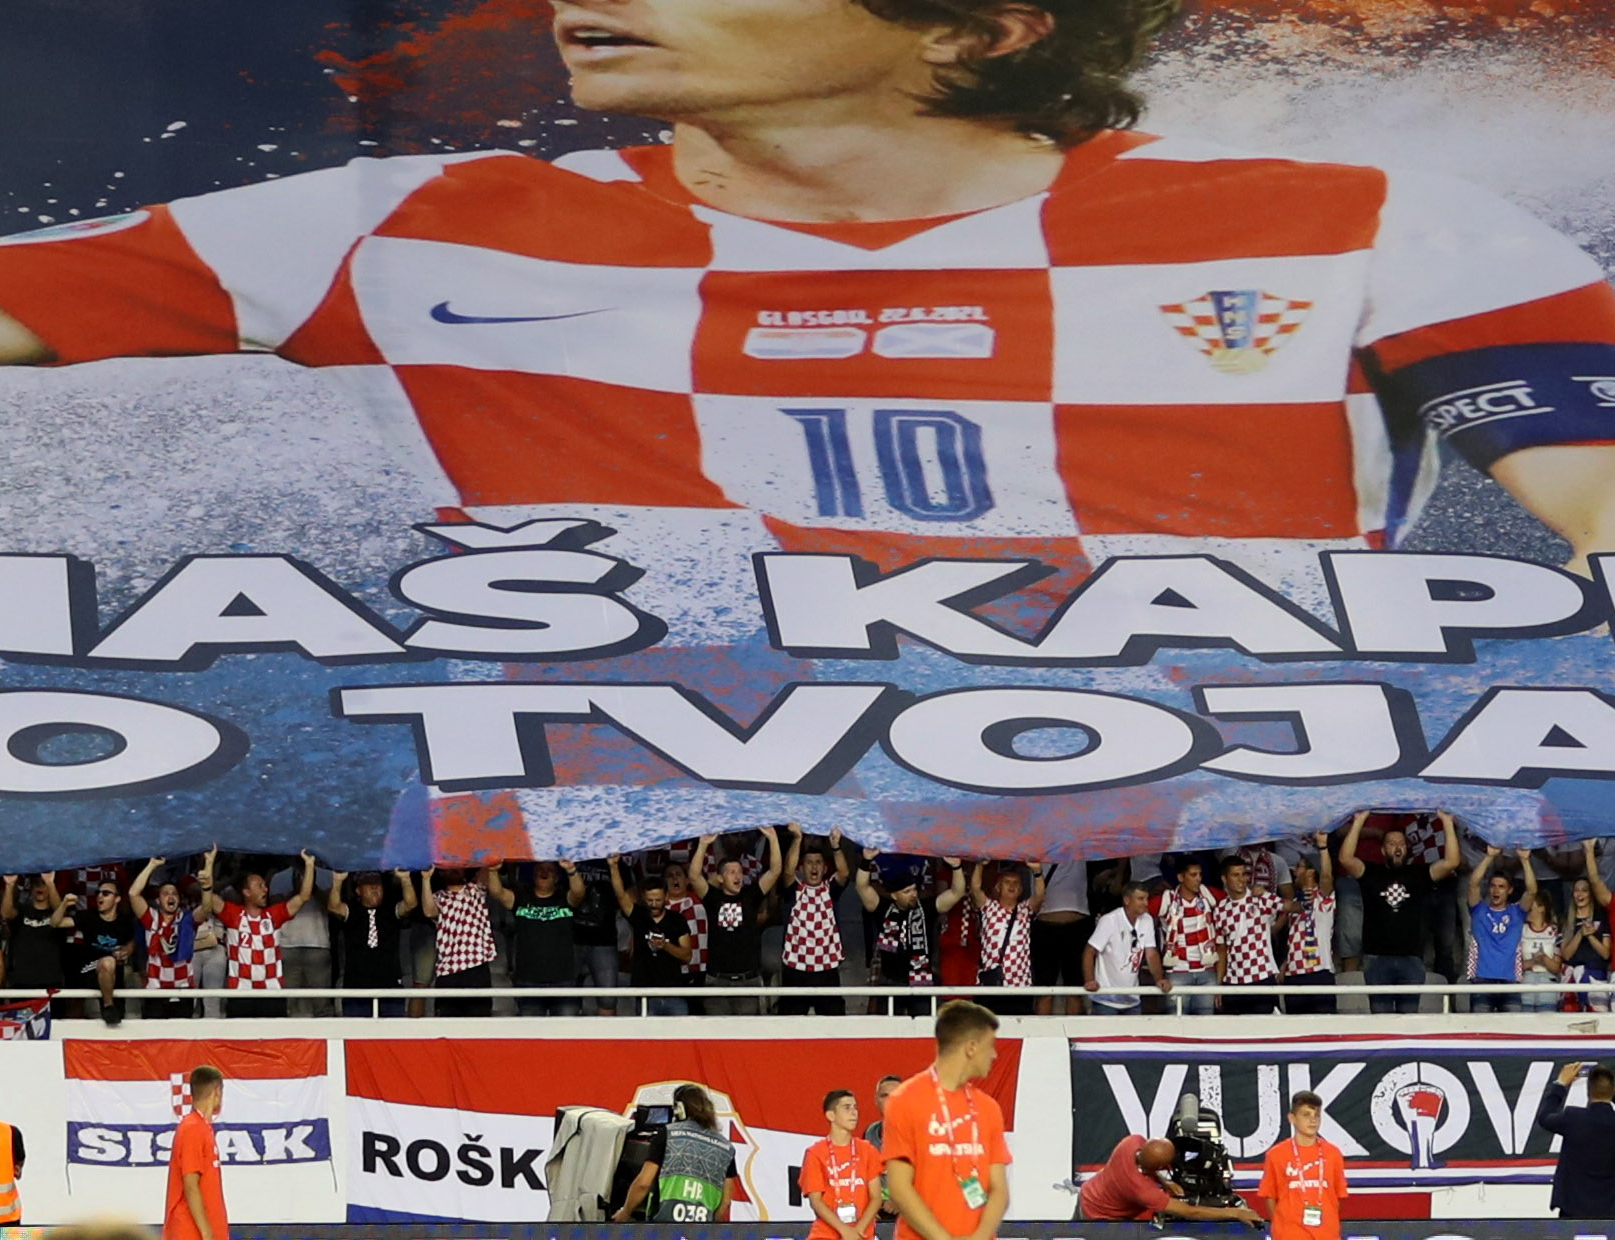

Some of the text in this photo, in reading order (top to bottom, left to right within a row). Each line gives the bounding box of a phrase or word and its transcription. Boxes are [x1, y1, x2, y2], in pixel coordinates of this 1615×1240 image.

[776, 408, 996, 523] 10
[240, 932, 249, 947] 2
[672, 1202, 708, 1223] 038
